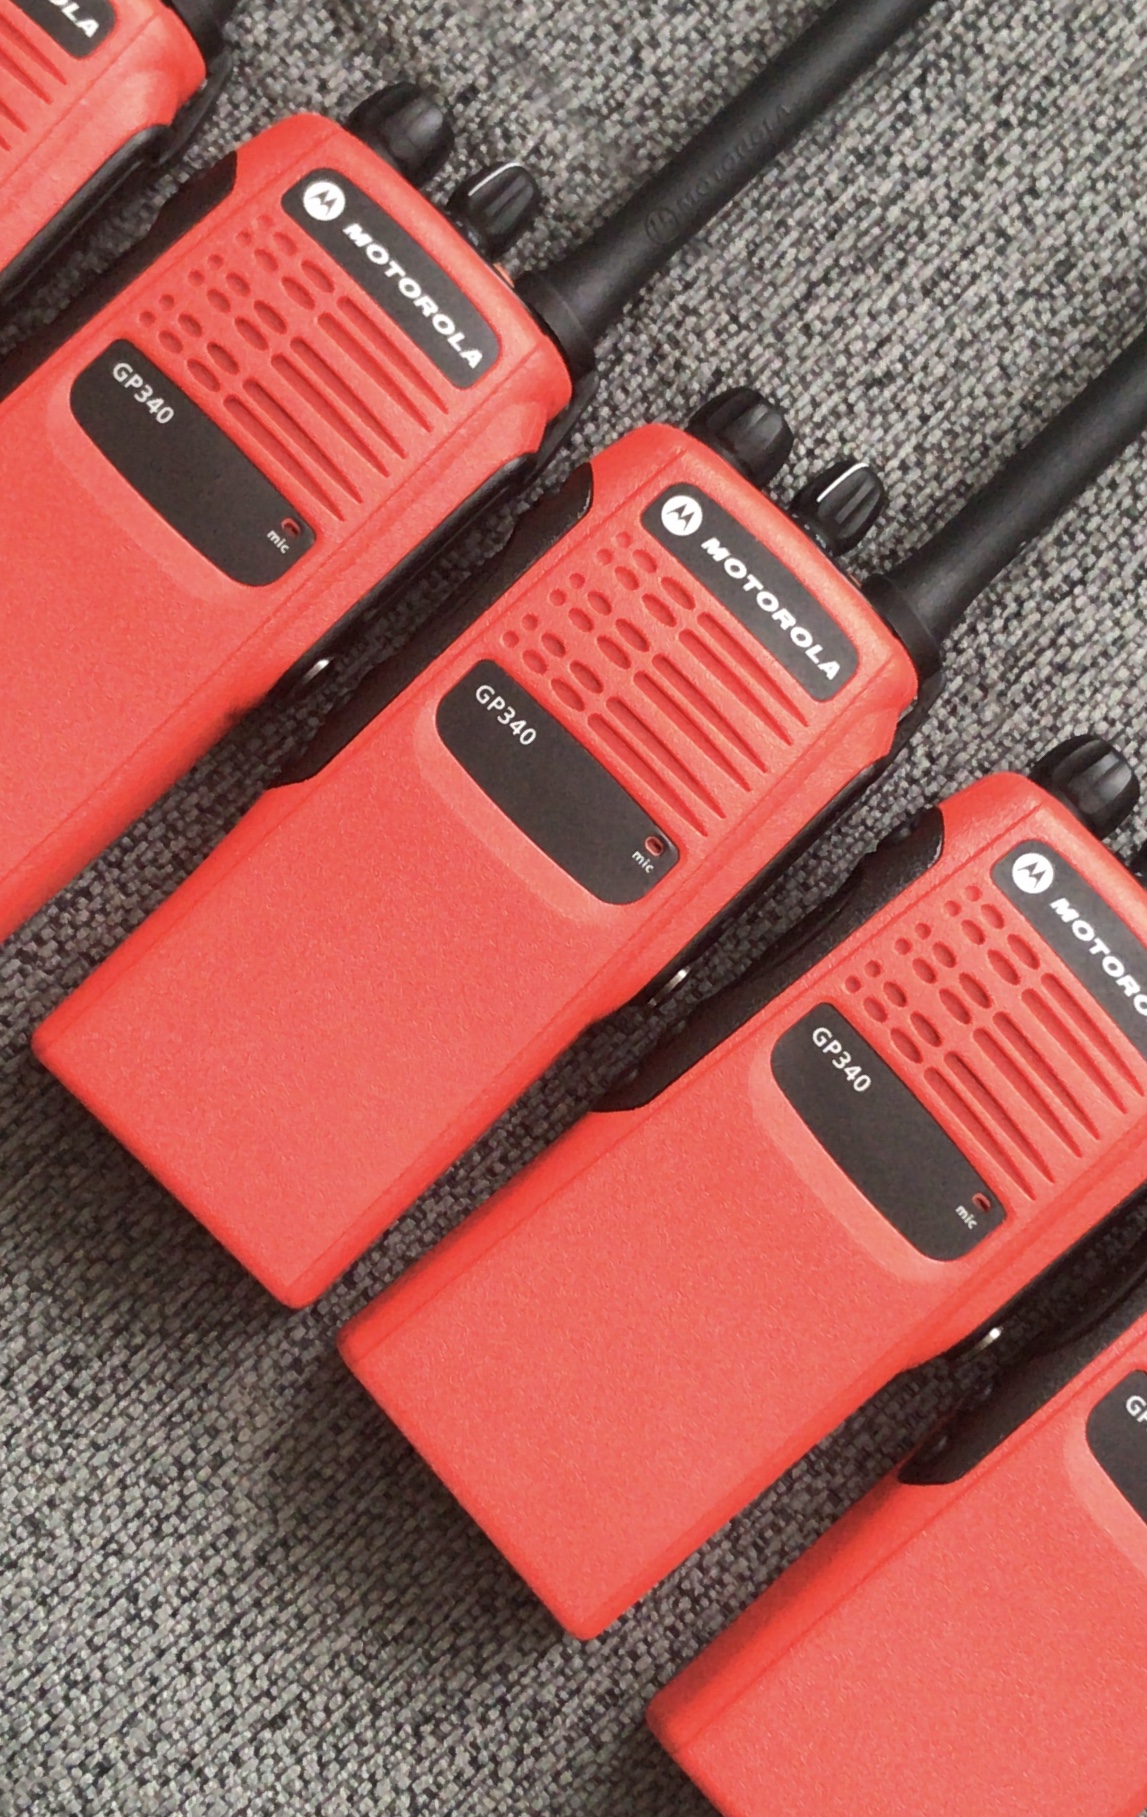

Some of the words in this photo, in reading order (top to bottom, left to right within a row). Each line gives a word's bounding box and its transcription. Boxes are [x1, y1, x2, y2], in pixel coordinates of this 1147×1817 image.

[49, 0, 99, 38] LA
[342, 222, 483, 369] MOTOROLA
[112, 362, 175, 424] GP340
[266, 529, 290, 554] mic
[700, 536, 841, 681] MOTOROLA
[475, 684, 537, 746] GP340
[631, 849, 655, 874] mic
[812, 1027, 872, 1092] GP340
[955, 1205, 978, 1230] mic
